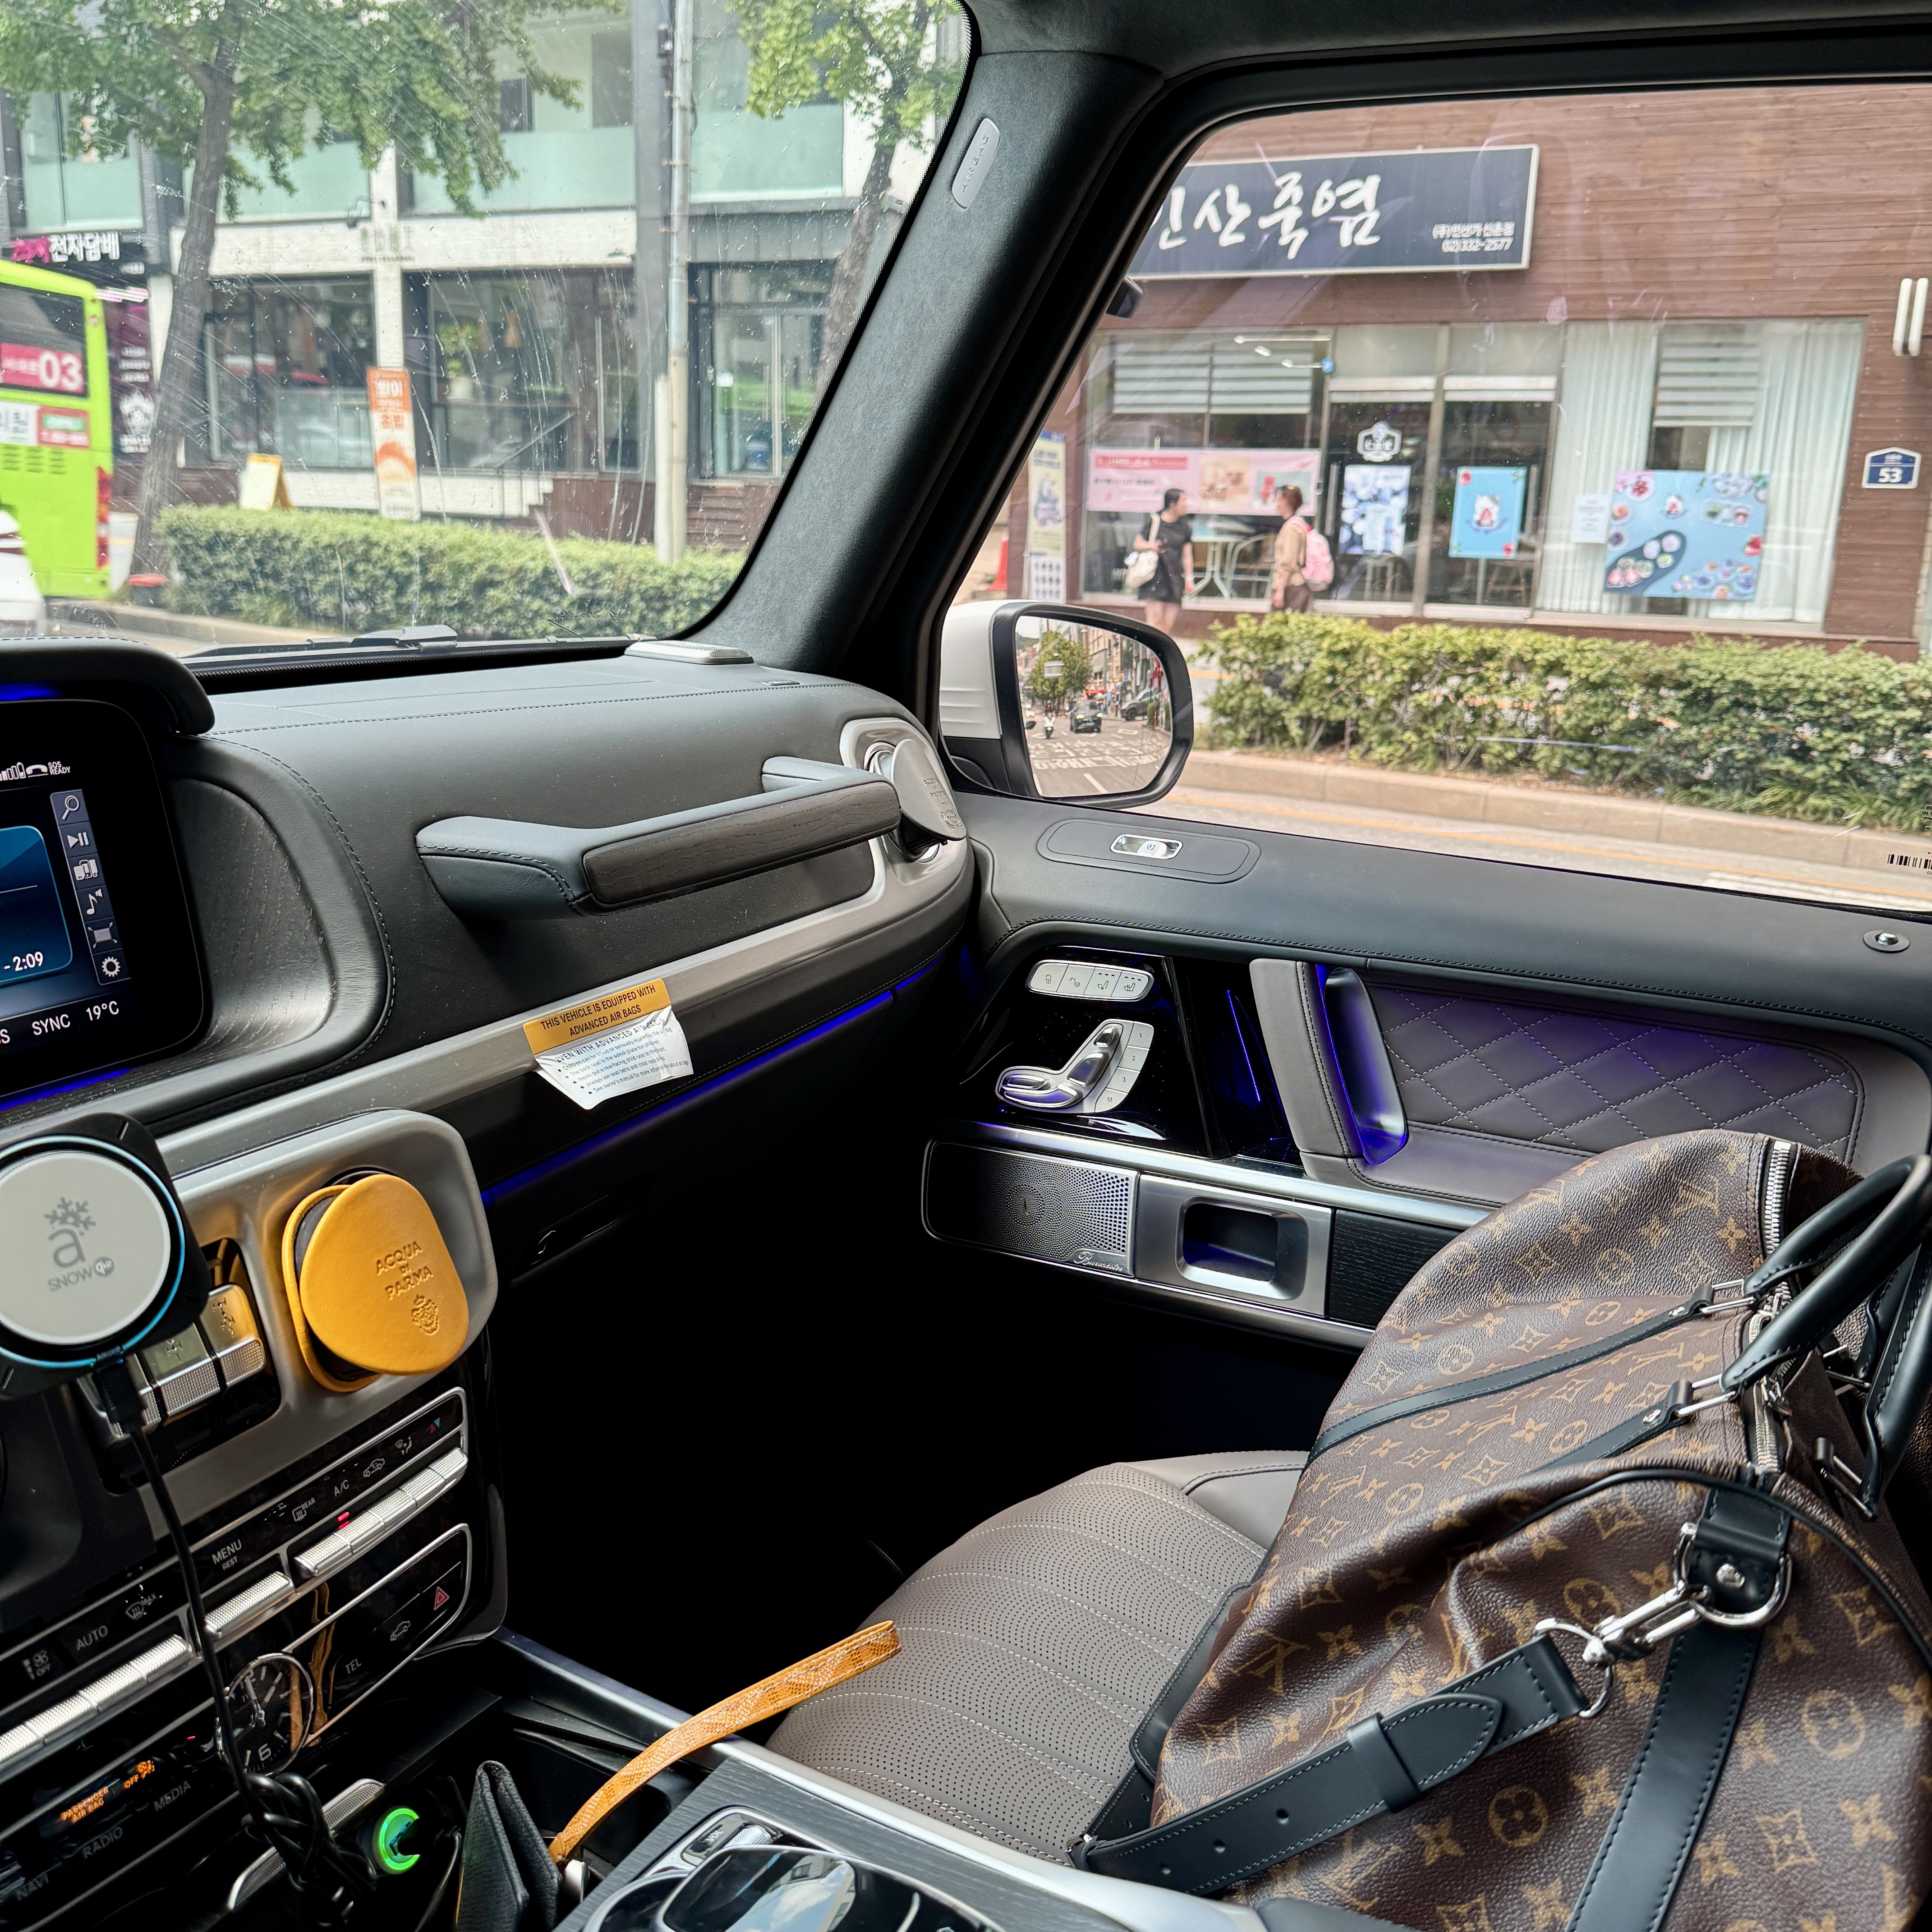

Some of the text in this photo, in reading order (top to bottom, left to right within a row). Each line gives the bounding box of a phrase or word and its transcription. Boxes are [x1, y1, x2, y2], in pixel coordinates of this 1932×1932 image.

[49, 231, 120, 262] 전자담배
[1878, 467, 1903, 483] 53
[50, 766, 70, 775] READY
[32, 1014, 70, 1035] SYNC
[86, 1001, 119, 1021] 19°C
[540, 984, 656, 1030] THIS VEHICLE IS EQUIPPED WITH
[570, 1004, 641, 1036] ADVANCED AIR BAGS
[574, 1044, 595, 1055] WITH
[595, 1030, 632, 1048] ADVANCED
[377, 1241, 423, 1276] ACQUA
[400, 1263, 412, 1276] DI
[48, 1265, 92, 1291] SNOW
[385, 1266, 434, 1301] PARMA
[334, 1479, 350, 1496] A/C
[301, 1497, 316, 1510] REAR
[212, 1539, 242, 1564] MENU
[222, 1556, 238, 1571] REST
[141, 1592, 157, 1606] MAX
[77, 1625, 108, 1651] AUTO
[345, 1658, 361, 1674] TEL
[258, 1743, 271, 1761] 6
[124, 1774, 139, 1789] OFF
[60, 1786, 109, 1821] PASSENGER
[153, 1780, 192, 1812] MEDIA
[71, 1798, 104, 1824] AIR BAG
[82, 1826, 123, 1858] RADIO
[14, 1872, 49, 1901] NAVI
